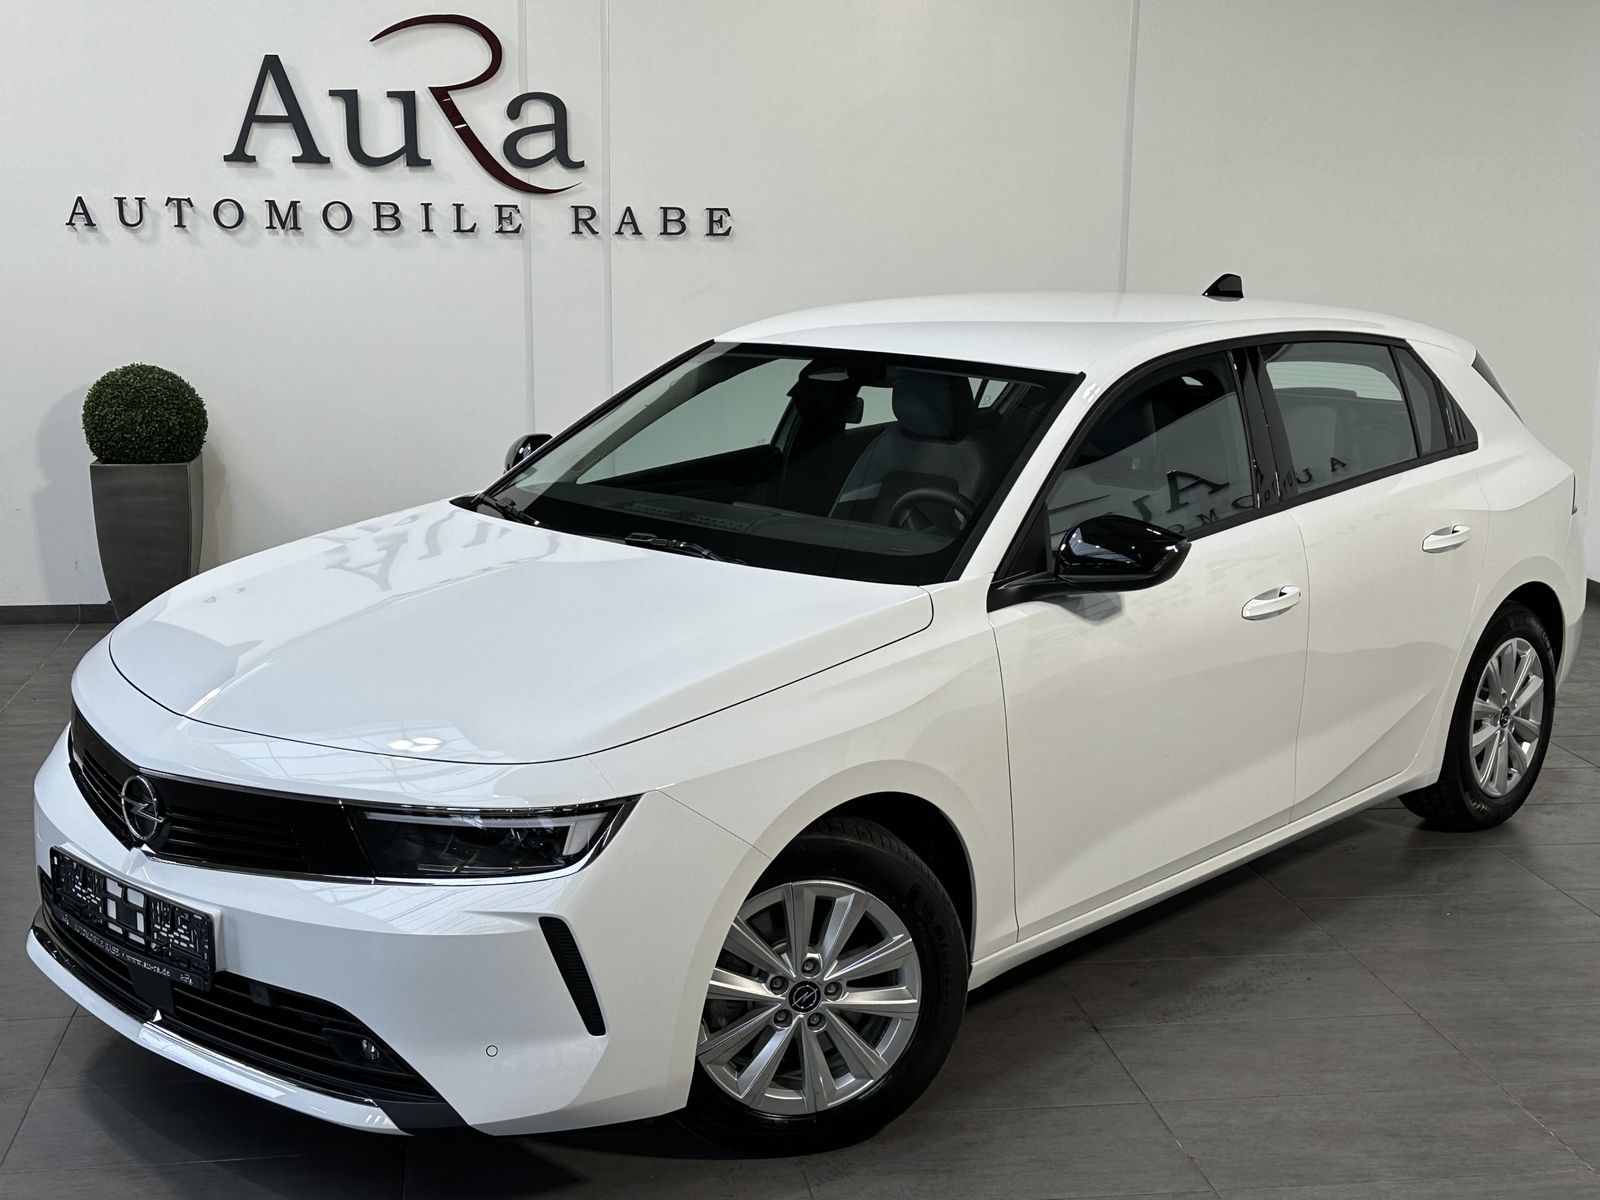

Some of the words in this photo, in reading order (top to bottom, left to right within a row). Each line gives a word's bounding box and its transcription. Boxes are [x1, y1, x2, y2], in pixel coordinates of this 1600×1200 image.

[223, 14, 584, 194] AuRa
[65, 196, 523, 234] AUTOMOBILE
[570, 205, 733, 238] RABE
